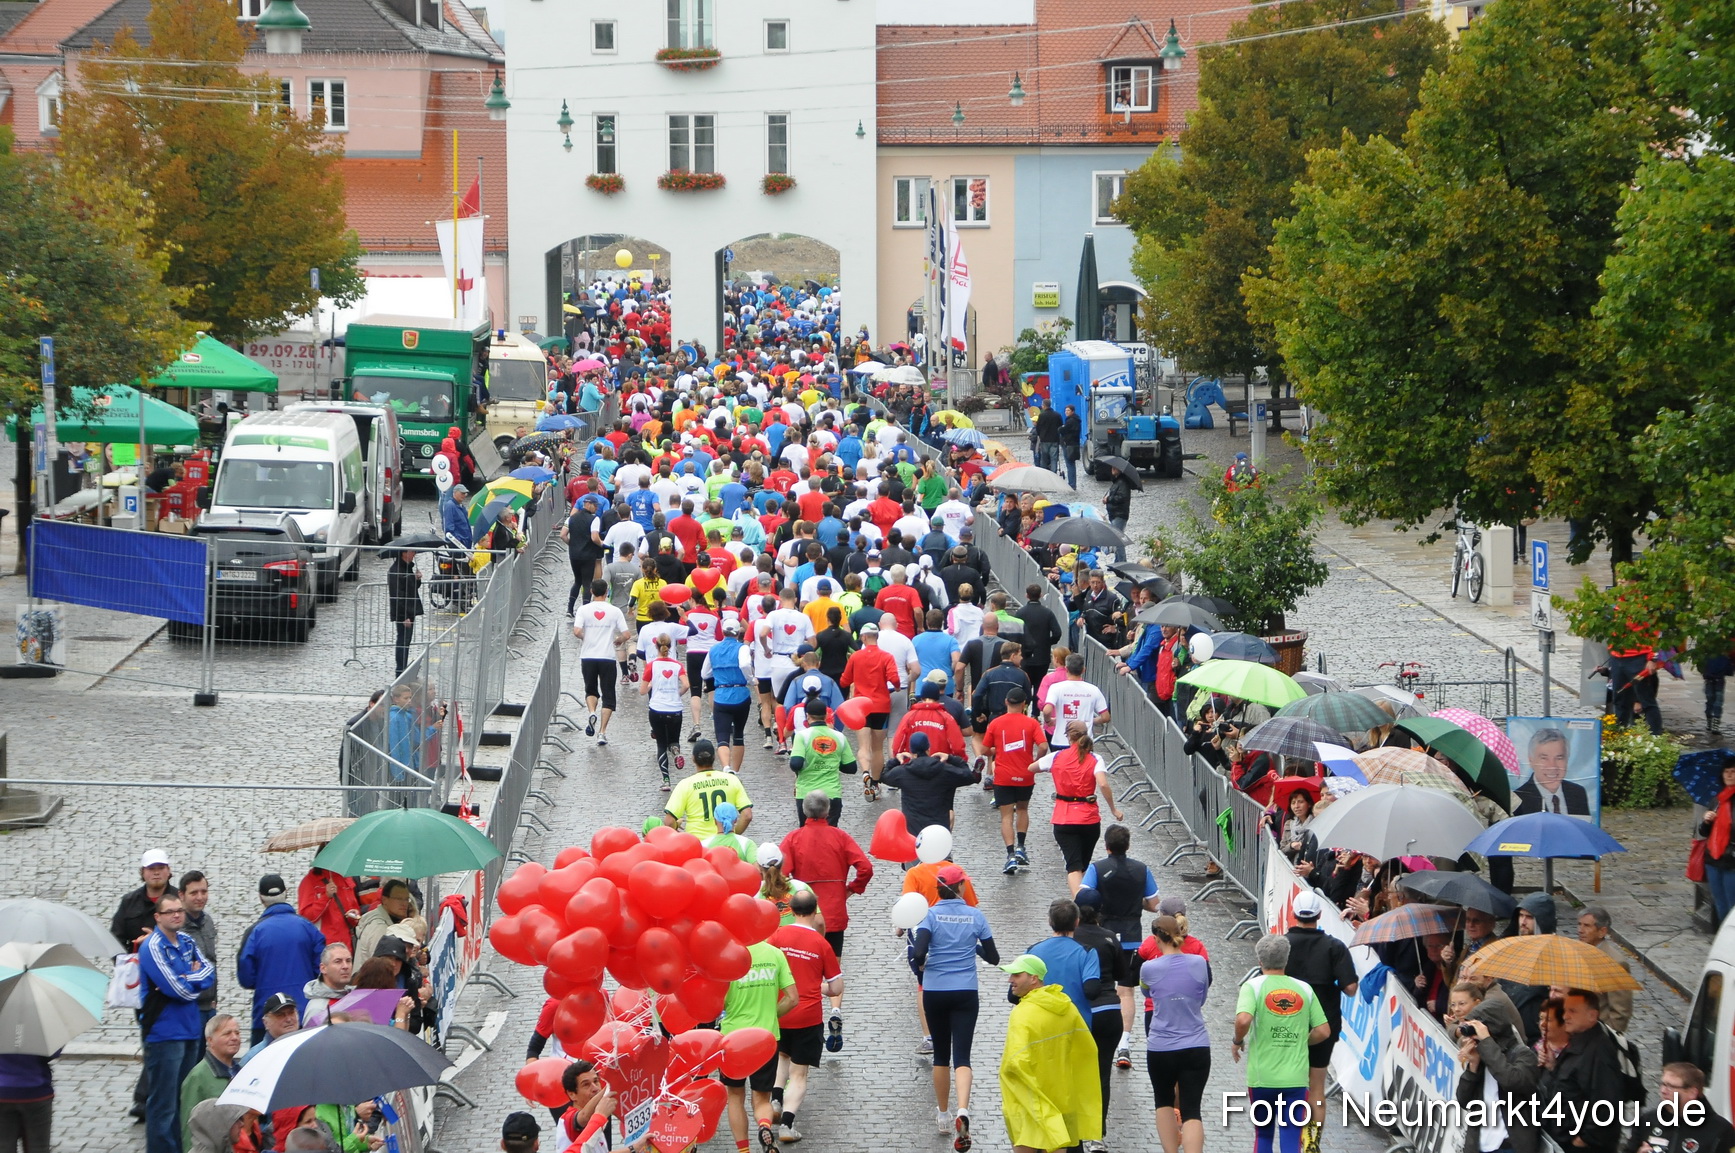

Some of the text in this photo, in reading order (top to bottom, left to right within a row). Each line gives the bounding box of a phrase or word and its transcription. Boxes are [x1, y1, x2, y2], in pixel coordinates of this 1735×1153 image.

[400, 427, 440, 437] Lammsbräu
[126, 498, 135, 510] P
[1535, 546, 1545, 581] P
[692, 779, 729, 790] RONALDINHO
[698, 789, 727, 822] 10
[750, 967, 777, 982] DAV
[1397, 1004, 1455, 1101] INTERSPORT
[629, 1068, 643, 1084] für
[619, 1073, 655, 1117] ROSI
[627, 1106, 652, 1134] 3333
[664, 1123, 678, 1133] für
[653, 1130, 689, 1147] Regina
